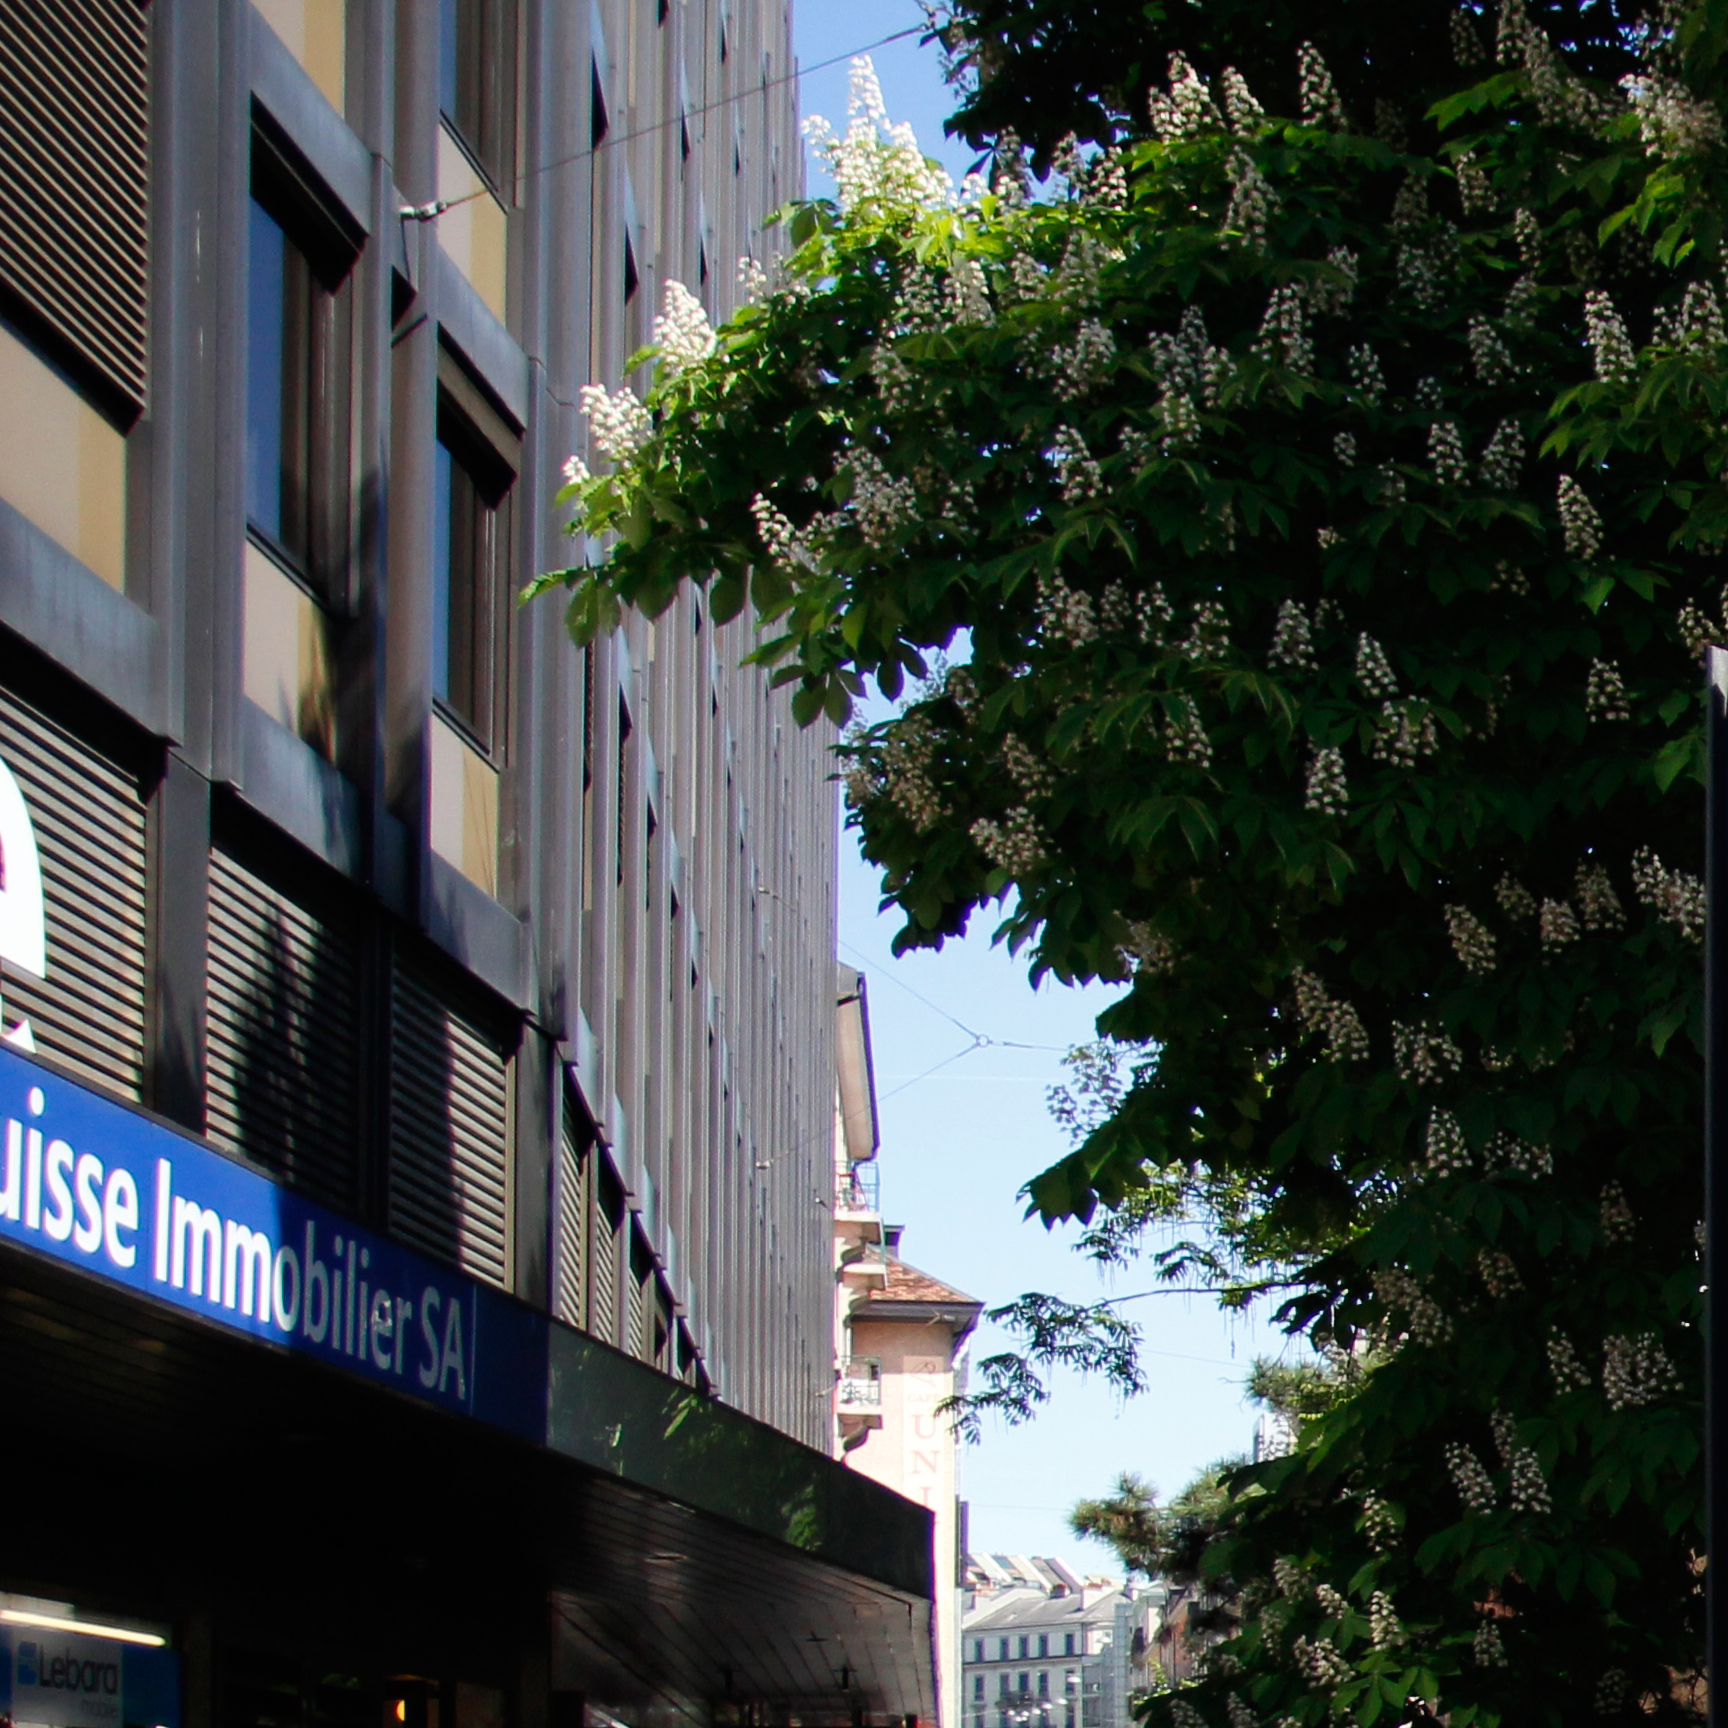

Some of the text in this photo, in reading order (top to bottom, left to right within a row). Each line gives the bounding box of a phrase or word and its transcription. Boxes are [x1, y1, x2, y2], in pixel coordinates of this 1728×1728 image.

[155, 1157, 412, 1373] Immobilier
[420, 1286, 467, 1401] SA
[39, 1645, 118, 1695] Lebara
